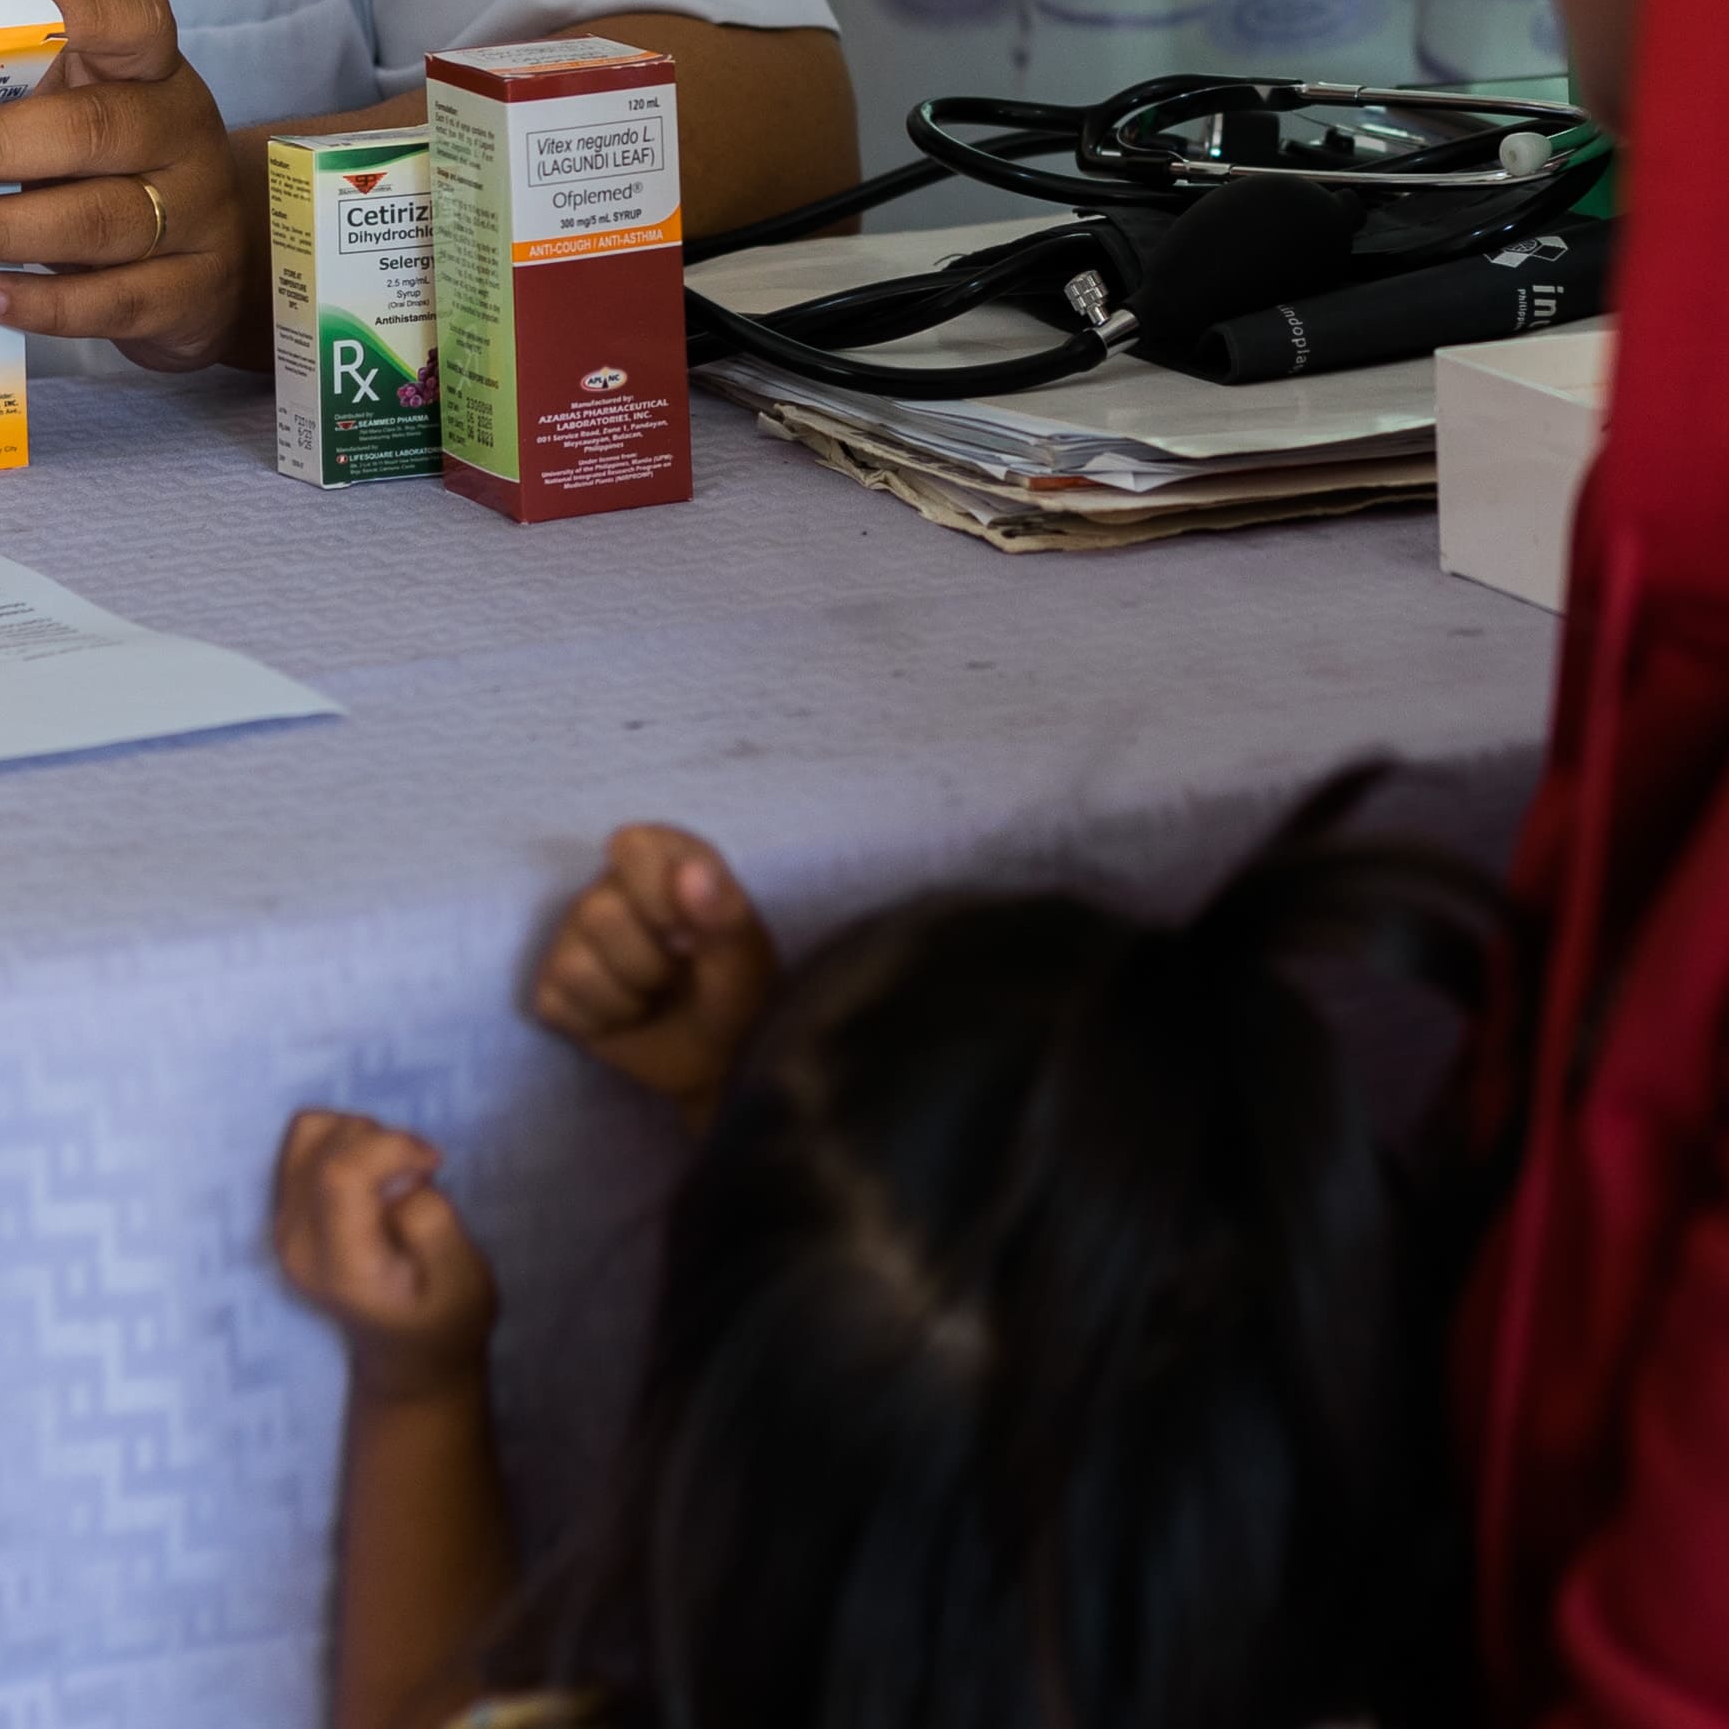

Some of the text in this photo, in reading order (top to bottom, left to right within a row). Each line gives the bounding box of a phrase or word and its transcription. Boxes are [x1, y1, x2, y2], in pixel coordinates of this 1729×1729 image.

[628, 97, 660, 111] 120 mL
[537, 125, 655, 155] Vitex negundo L.
[537, 147, 655, 181] (LAGUNDI LEAF)
[560, 209, 642, 229] 300 mg/5 mL SYRUP
[529, 229, 663, 257] ANTI-COUGH ANTI-ASTHMA
[387, 276, 430, 288] 2.5 mg/mL
[397, 290, 421, 299] Syrup
[388, 301, 405, 309] (Oral
[1528, 284, 1565, 328] in
[333, 339, 380, 403] Rx
[571, 396, 621, 409] Manufactured
[538, 399, 669, 424] AZARIAS PHARMACEUTICAL
[633, 411, 652, 419] INC.
[397, 414, 429, 424] PHARMA
[553, 432, 579, 441] Service
[583, 442, 624, 453] Philippines
[349, 451, 393, 461] LIFESQUARE
